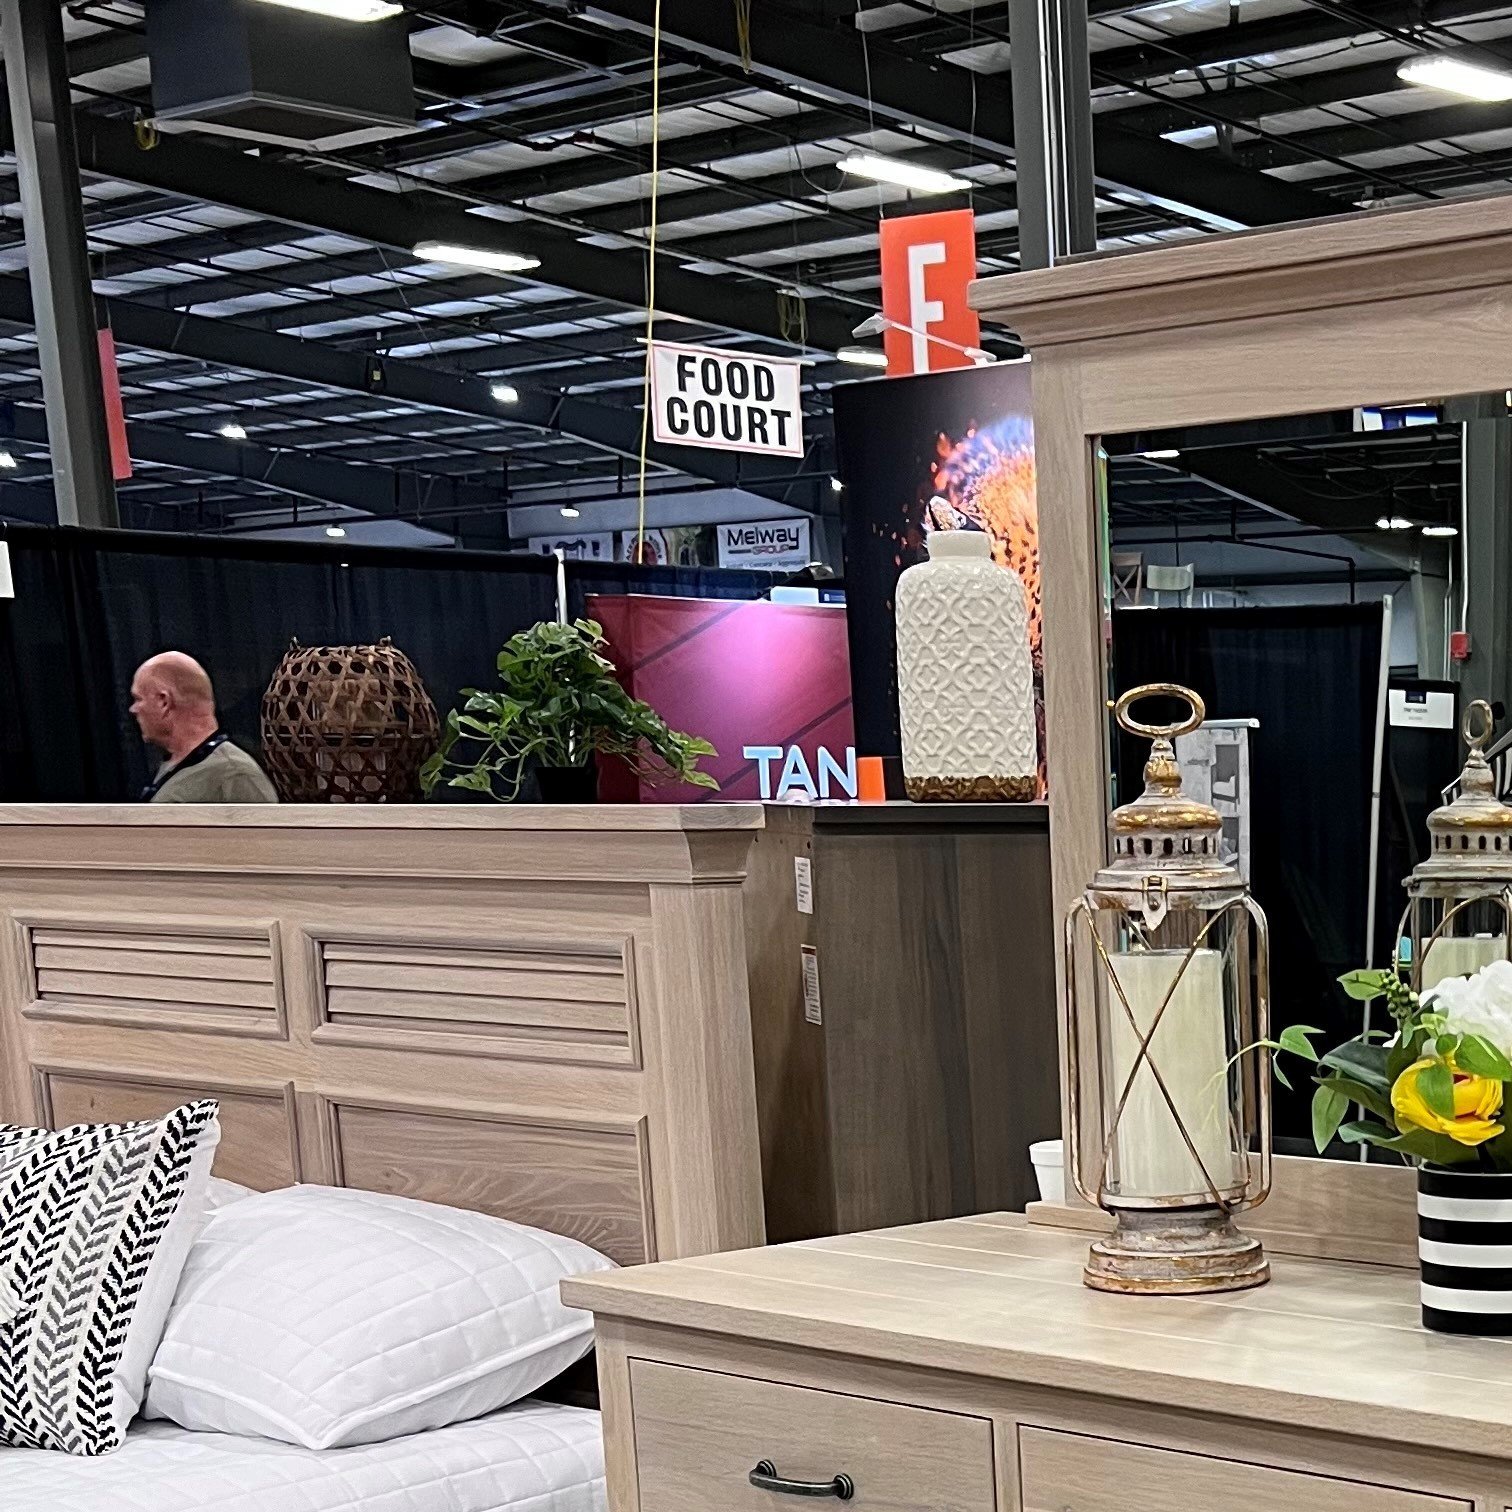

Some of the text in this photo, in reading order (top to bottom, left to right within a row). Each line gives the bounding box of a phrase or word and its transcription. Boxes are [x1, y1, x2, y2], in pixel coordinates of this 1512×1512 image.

[907, 241, 946, 375] F
[677, 354, 775, 402] FOOD
[666, 396, 792, 447] COURT
[743, 744, 858, 799] TAN
